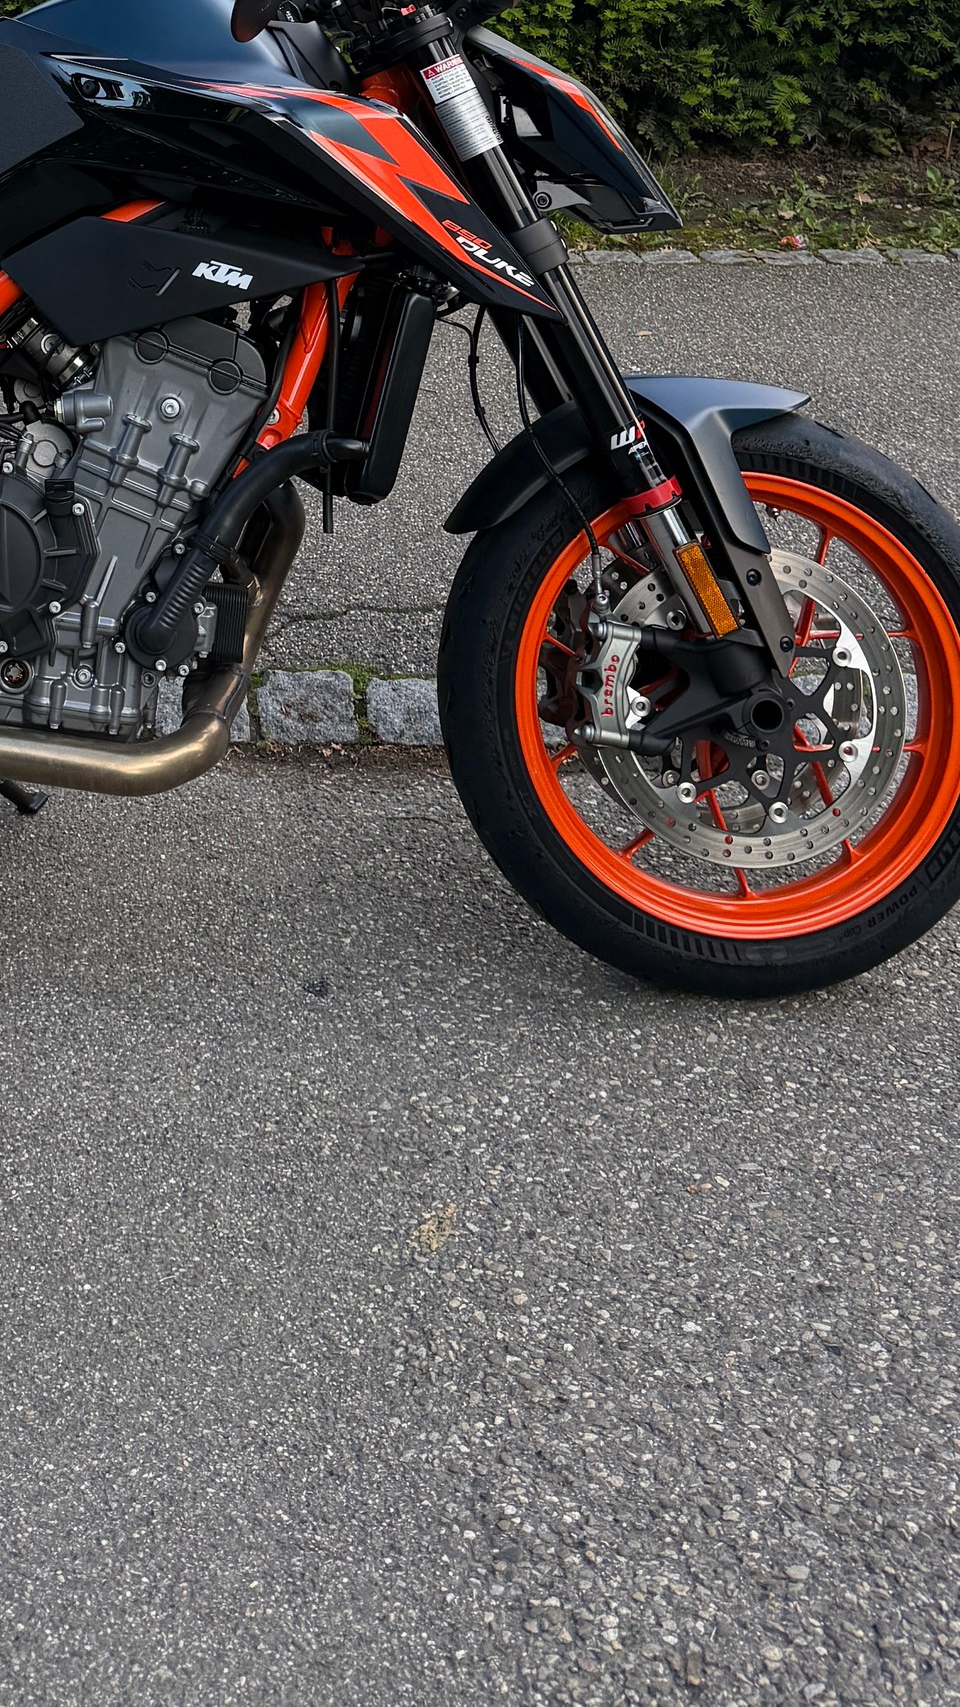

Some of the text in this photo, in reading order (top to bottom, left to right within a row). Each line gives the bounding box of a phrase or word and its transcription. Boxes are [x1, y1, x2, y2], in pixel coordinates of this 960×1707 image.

[191, 259, 254, 290] KTM
[455, 236, 535, 287] DUKE
[601, 654, 620, 717] brembo
[867, 884, 918, 928] POWER
